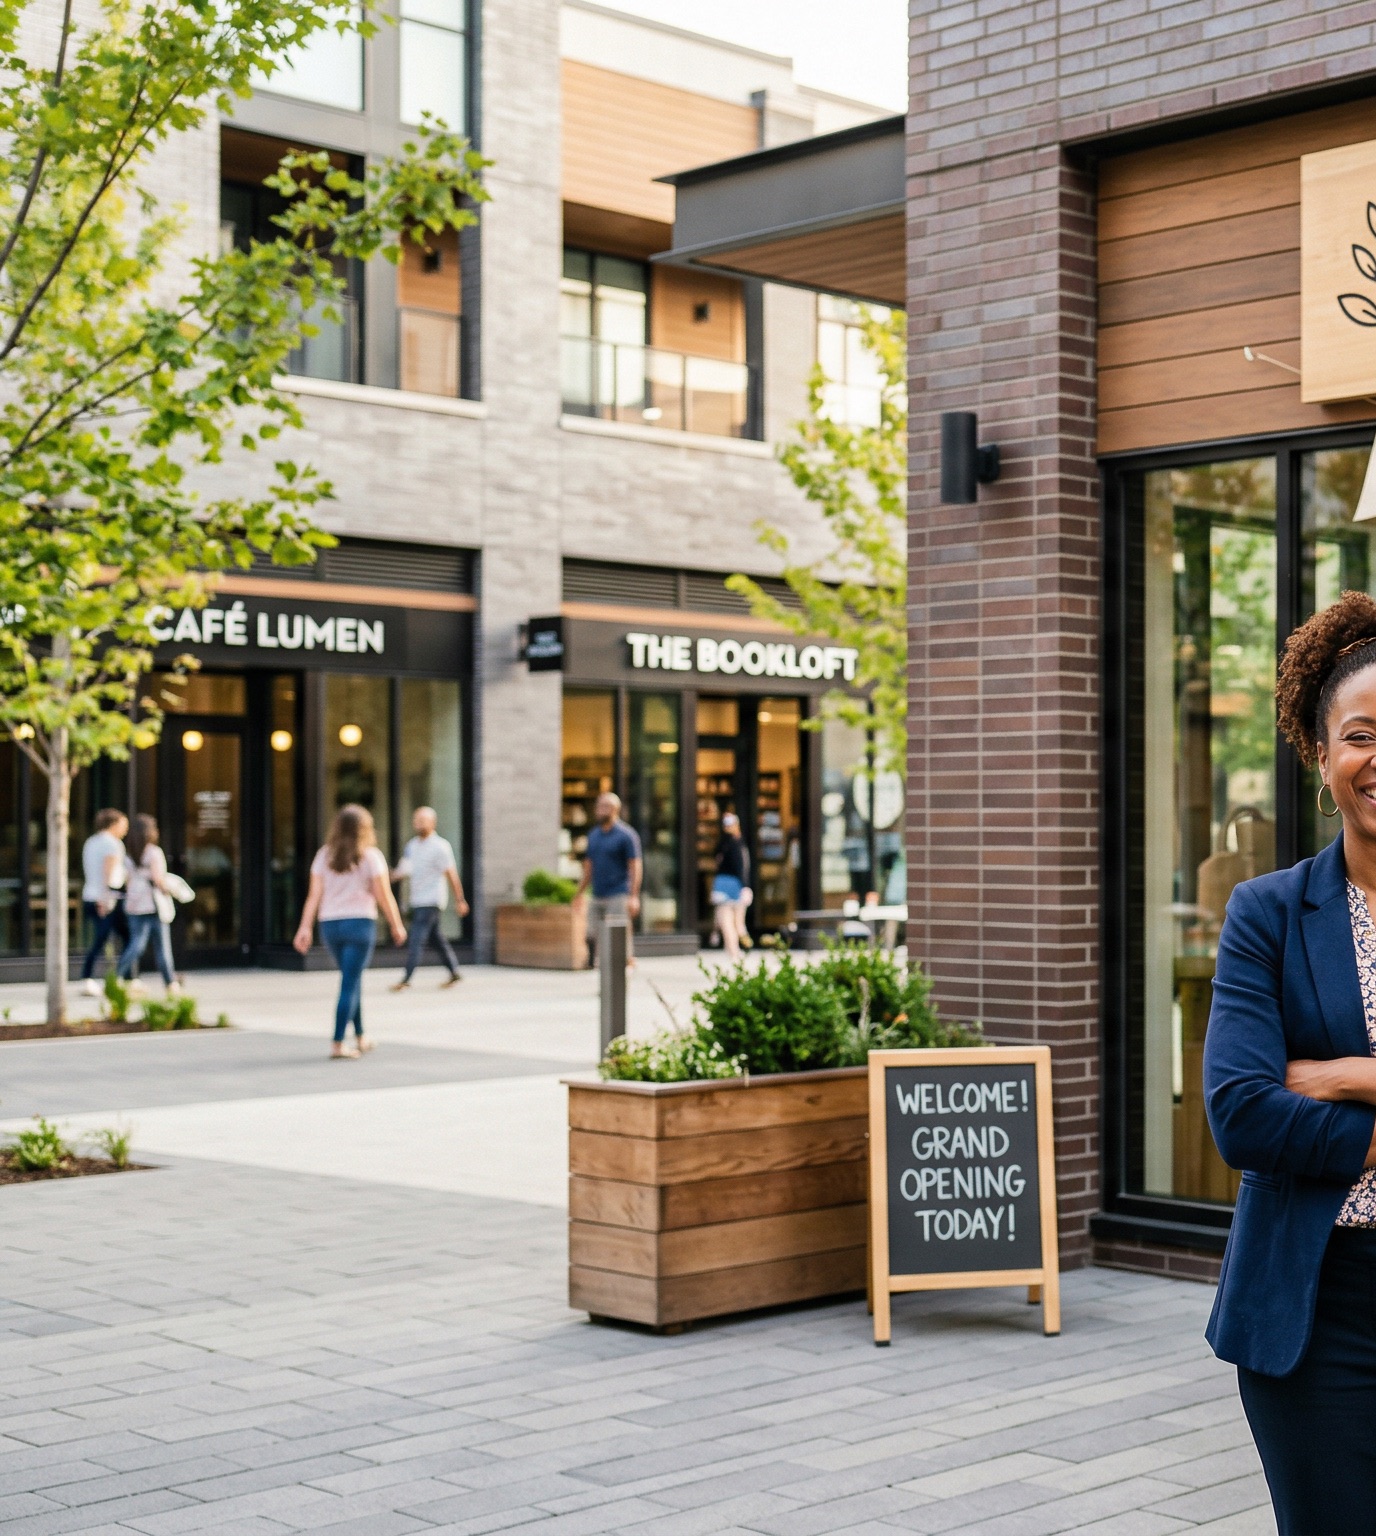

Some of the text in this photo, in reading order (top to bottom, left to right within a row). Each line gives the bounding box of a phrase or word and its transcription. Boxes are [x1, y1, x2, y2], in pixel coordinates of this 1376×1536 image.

[144, 601, 384, 655] CAFÉ LUMEN
[626, 632, 859, 681] THE BOOKLOFT
[896, 1079, 1029, 1115] WELCOME!
[911, 1126, 1010, 1160] GRAND
[900, 1164, 1026, 1201] OPENING
[914, 1203, 1016, 1242] TODAY!
